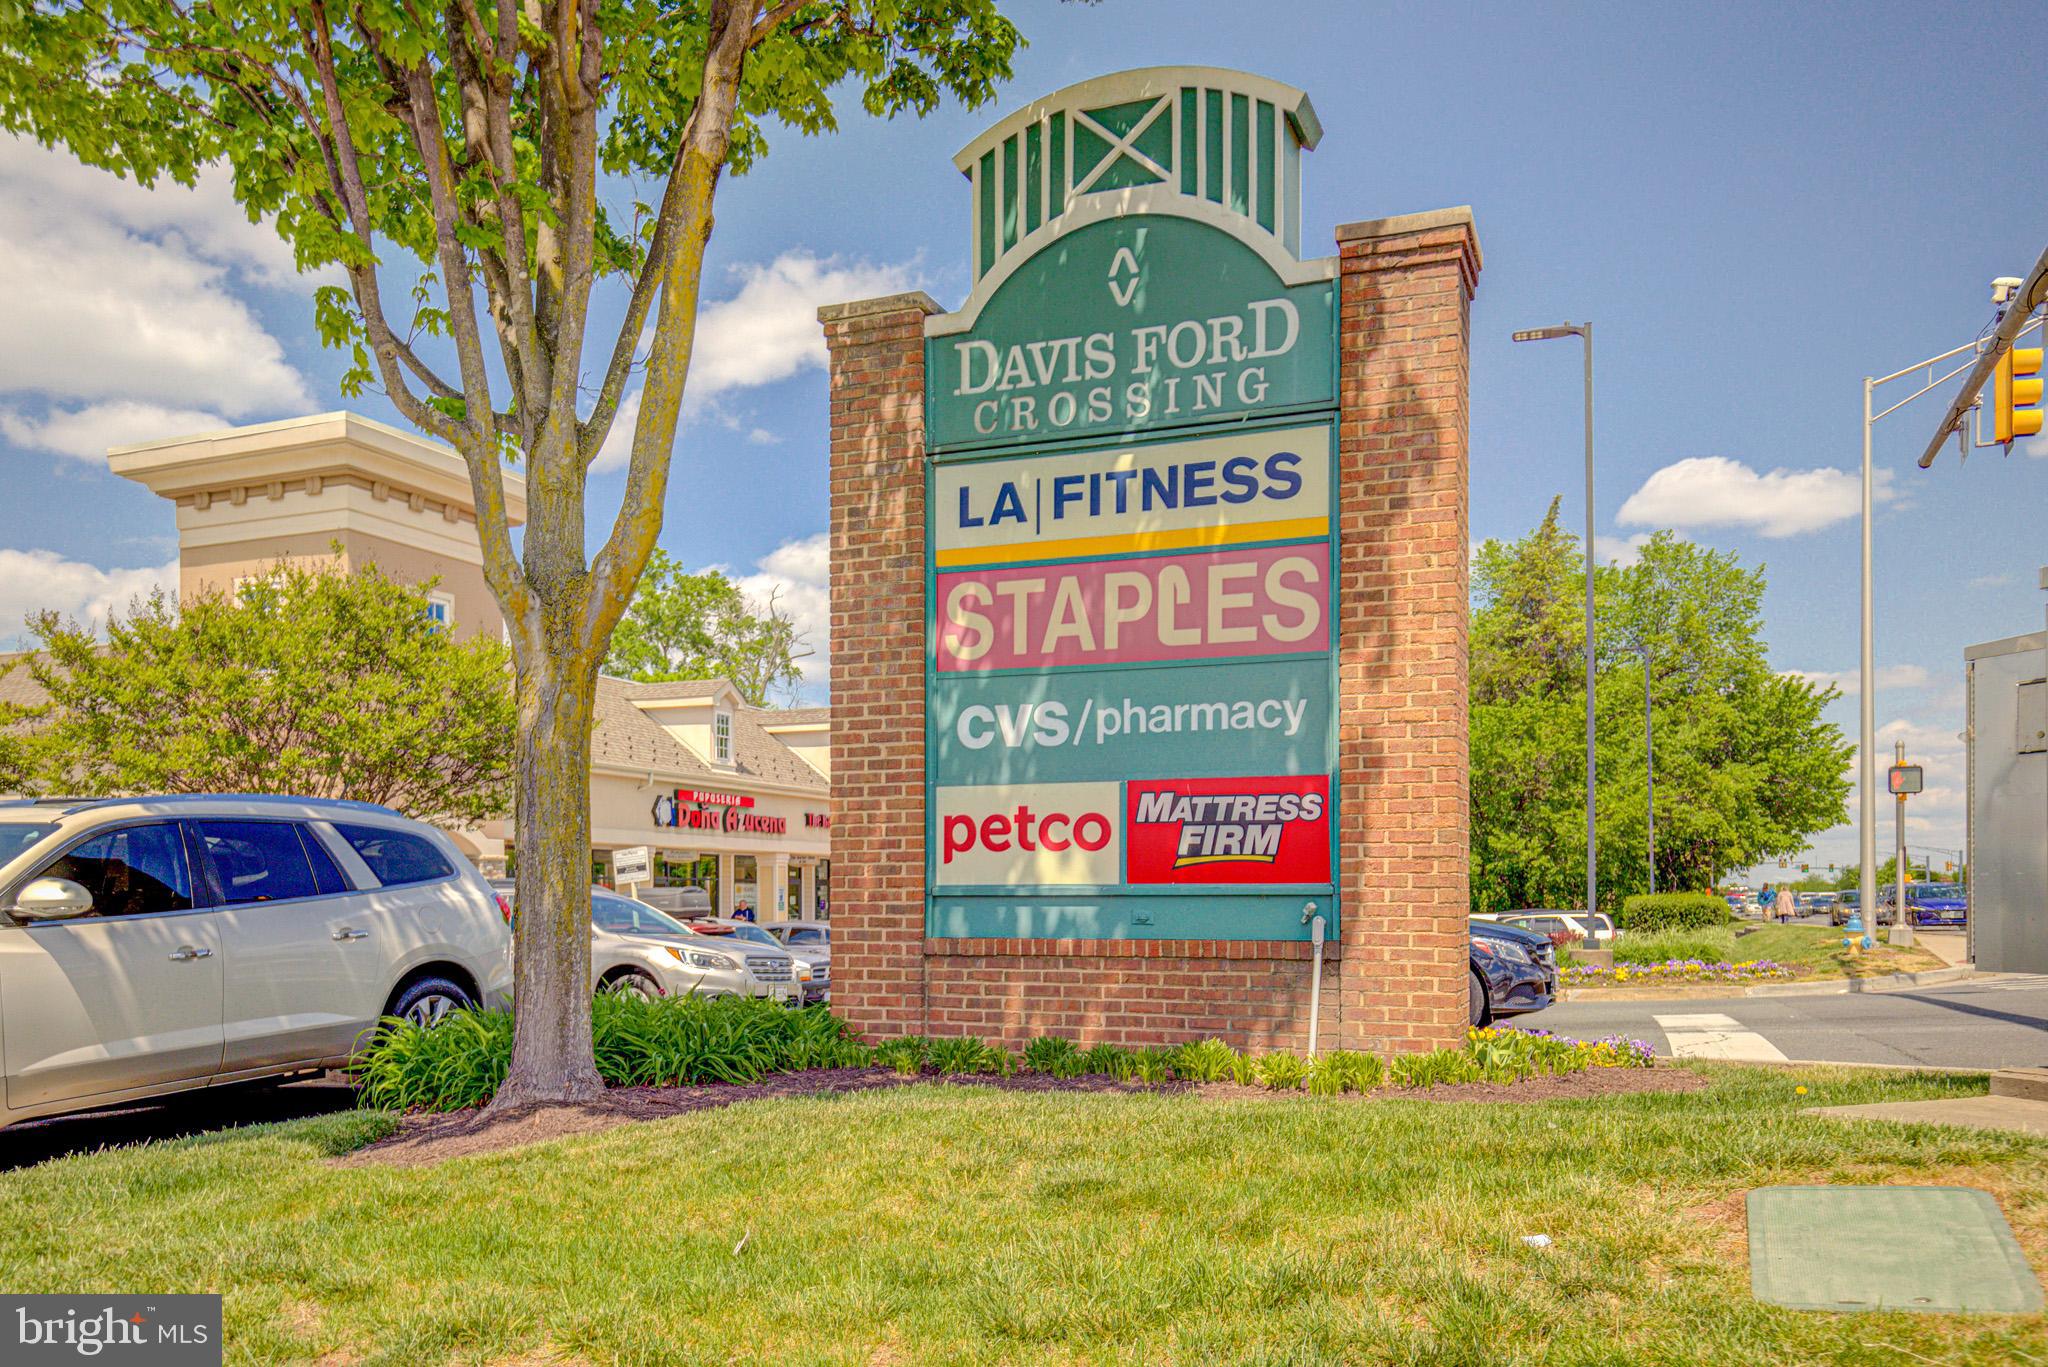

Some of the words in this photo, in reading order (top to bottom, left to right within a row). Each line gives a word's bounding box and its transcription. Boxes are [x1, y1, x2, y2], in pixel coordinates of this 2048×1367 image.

[953, 333, 1117, 396] DAVIS
[1131, 298, 1300, 374] FORD
[973, 367, 1270, 434] CROSSING
[944, 556, 1321, 662] STAPLES
[724, 806, 786, 834] Azucena
[943, 805, 1112, 864] petco
[1135, 790, 1324, 824] MATTRESS
[1176, 822, 1284, 858] FIRM
